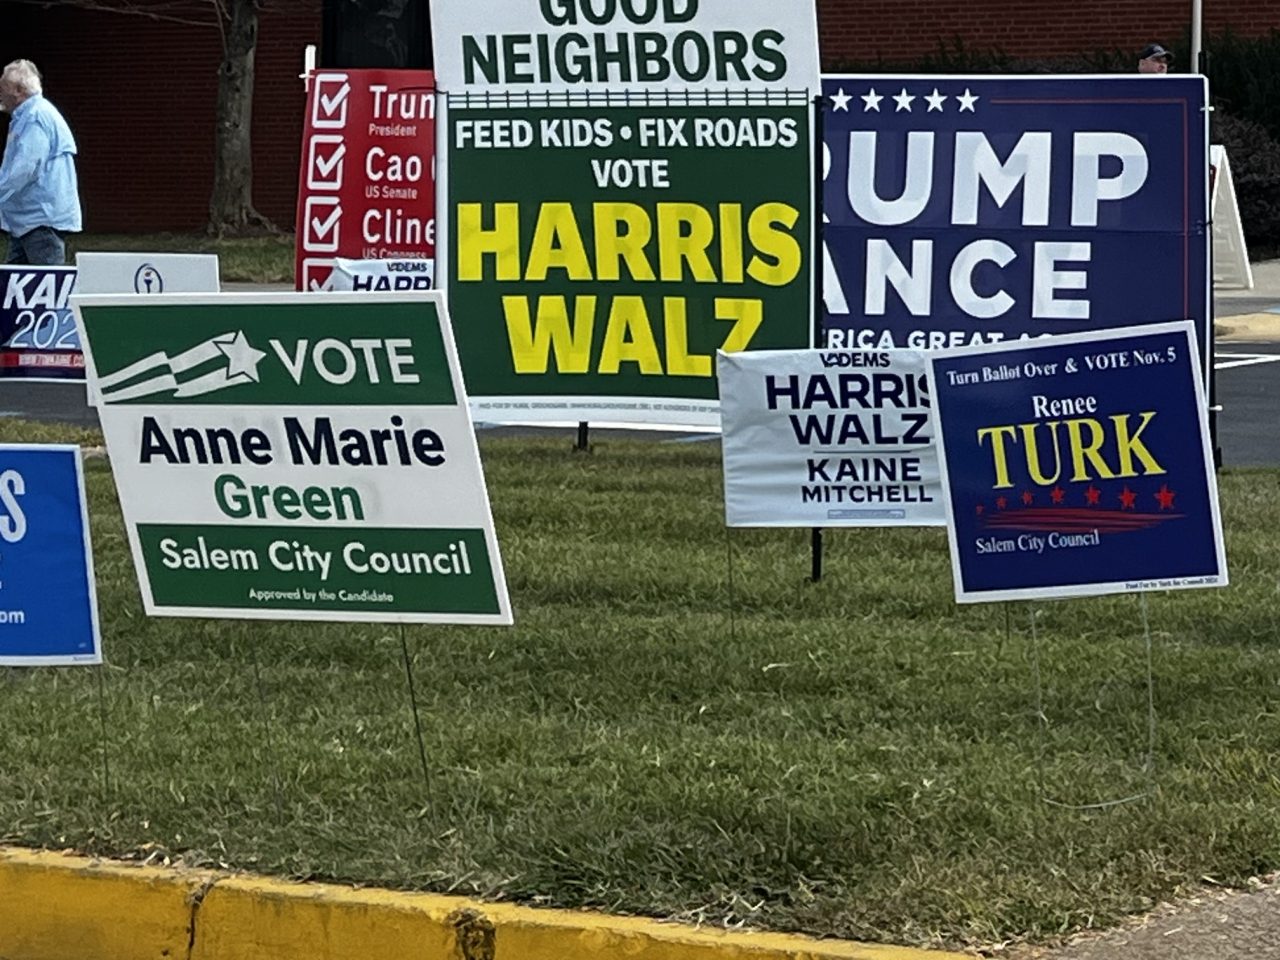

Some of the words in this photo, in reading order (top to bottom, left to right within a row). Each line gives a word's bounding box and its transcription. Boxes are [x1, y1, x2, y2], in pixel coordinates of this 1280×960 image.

[461, 29, 788, 84] NEIGHBORS
[369, 85, 435, 120] Tru
[368, 123, 417, 137] President
[455, 119, 533, 148] FEED
[541, 118, 613, 148] KIDS
[638, 118, 686, 147] FIX
[694, 118, 798, 148] ROADS
[365, 146, 422, 182] Cao
[591, 159, 670, 188] VOTE
[823, 131, 1149, 227] UMP
[365, 186, 380, 198] US
[382, 186, 418, 199] Senate
[362, 209, 436, 246] Cline
[457, 202, 802, 286] HARRIS
[362, 247, 378, 259] US
[3, 273, 77, 309] KAI
[353, 275, 432, 291] HARR
[10, 311, 78, 349] 202
[502, 295, 763, 377] WALZ
[823, 329, 895, 350] RICA
[269, 338, 420, 385] VOTE
[946, 370, 979, 386] Turn
[983, 365, 1021, 382] Ballot
[1024, 361, 1058, 378] Over
[1064, 358, 1079, 374] &
[1085, 352, 1130, 371] VOTE
[1133, 350, 1166, 367] Nov.
[1167, 346, 1177, 362] 5
[765, 373, 931, 410] HARRIS
[1032, 395, 1097, 418] Renee
[139, 416, 273, 465] Anne
[283, 415, 445, 466] Marie
[789, 413, 931, 445] WALZ
[977, 411, 1167, 489] TURK
[807, 458, 921, 482] KAINE
[214, 473, 365, 521] Green
[801, 485, 934, 503] MITCHELL
[160, 537, 259, 570] Salem
[268, 540, 332, 580] City
[343, 542, 471, 575] Council
[975, 537, 1016, 554] Salem
[1018, 533, 1046, 554] City
[1048, 528, 1100, 548] Council
[249, 588, 301, 601] Approved
[303, 588, 317, 602] by
[319, 588, 336, 600] the
[338, 589, 394, 602] Candidate
